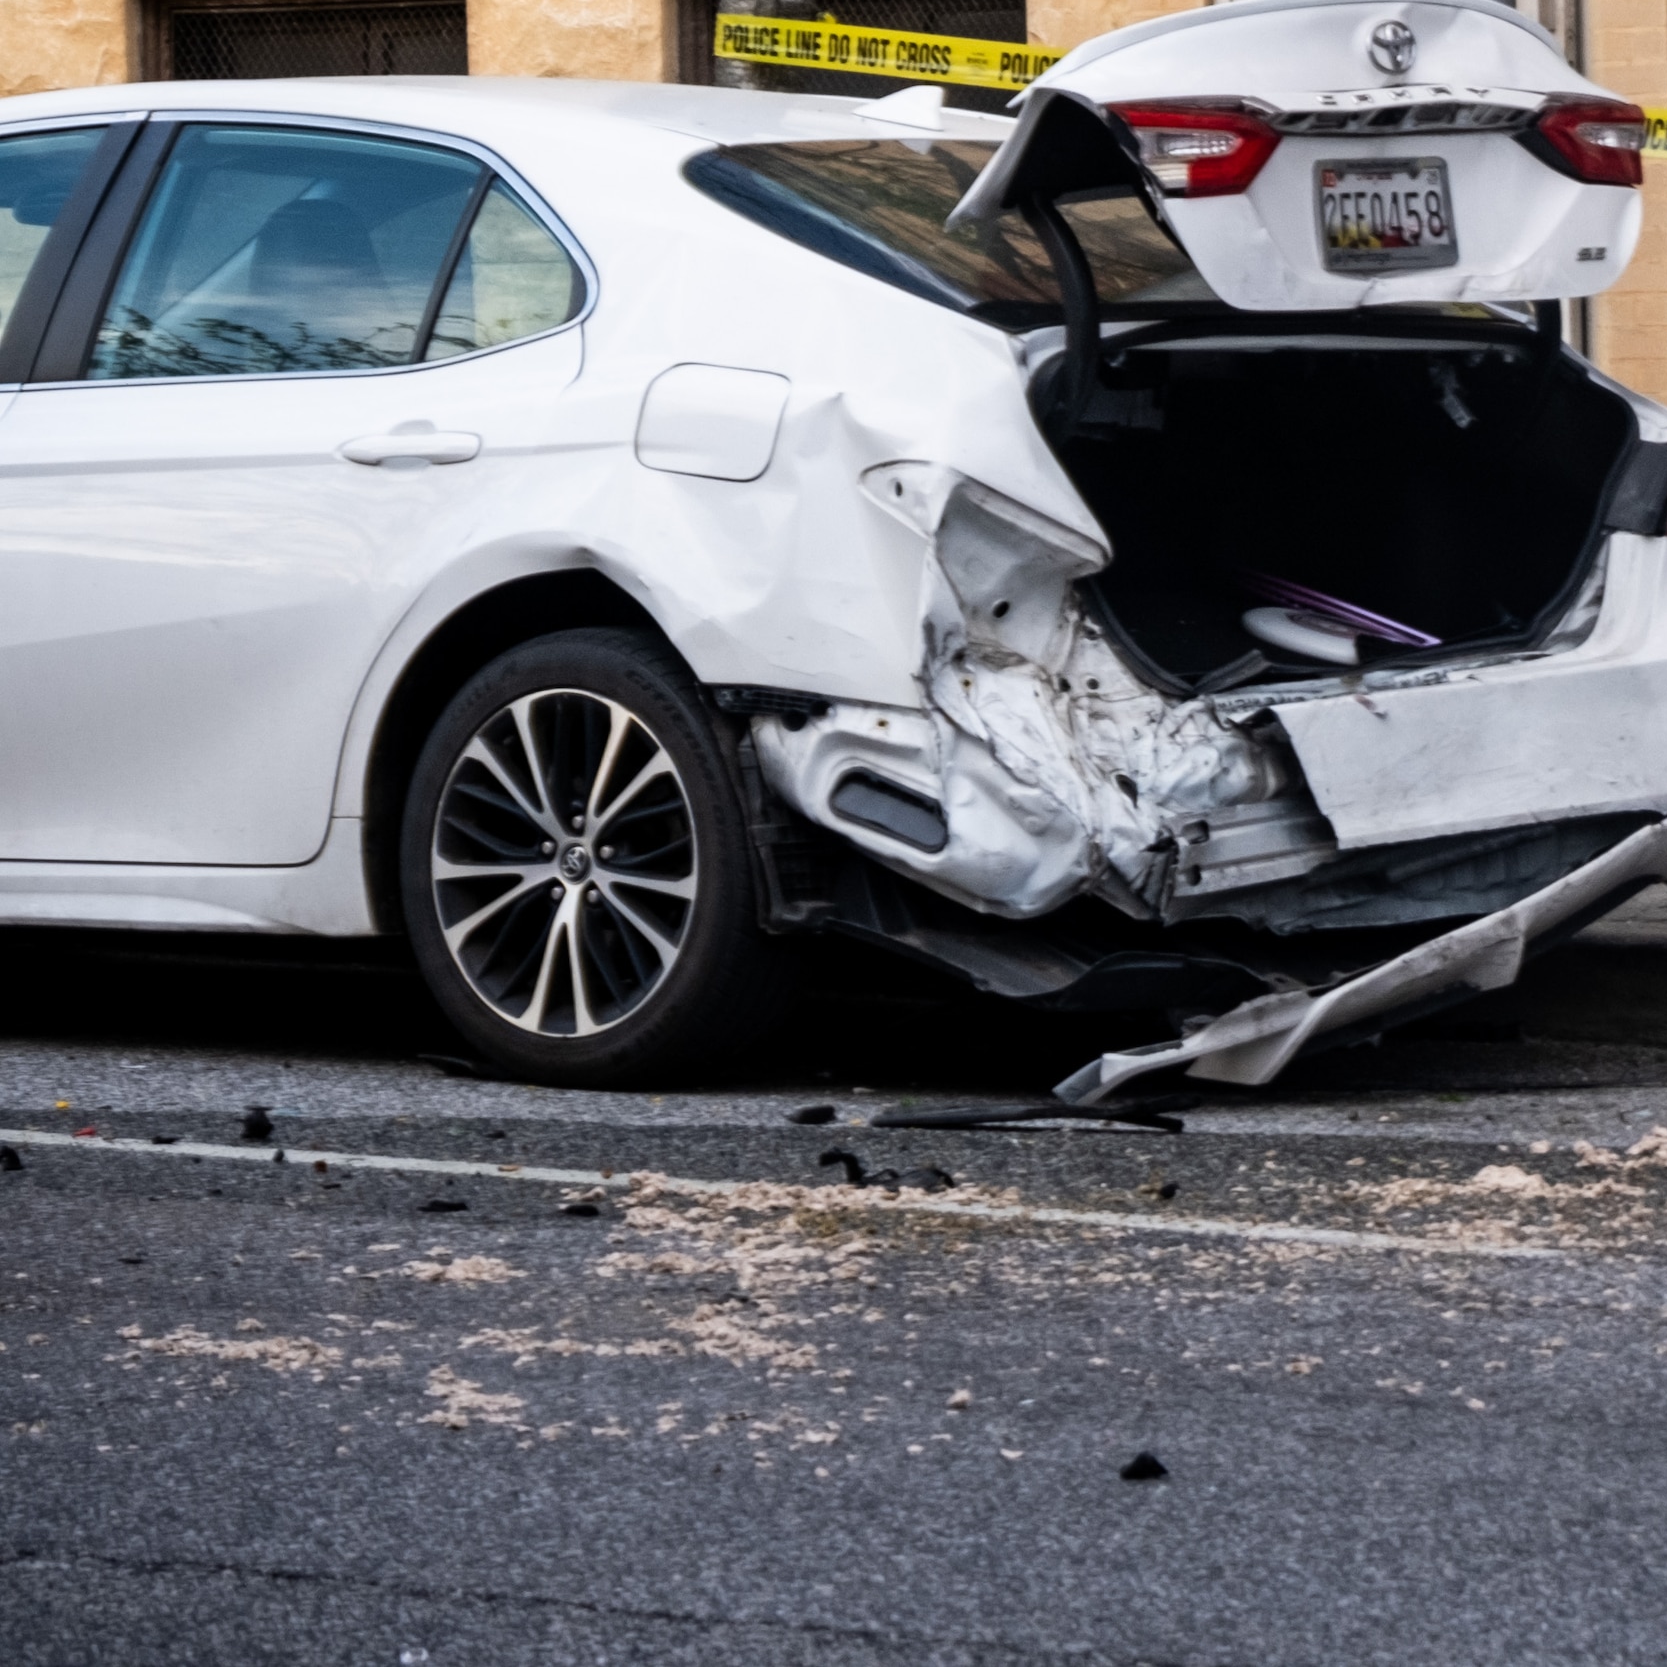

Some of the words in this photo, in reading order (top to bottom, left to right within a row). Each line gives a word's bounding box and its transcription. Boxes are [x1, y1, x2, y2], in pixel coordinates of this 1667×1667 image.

[722, 24, 779, 57] POLICE
[786, 29, 821, 61] LINE
[828, 34, 850, 64] DO
[856, 37, 890, 69] NOT
[896, 43, 952, 76] CROSS
